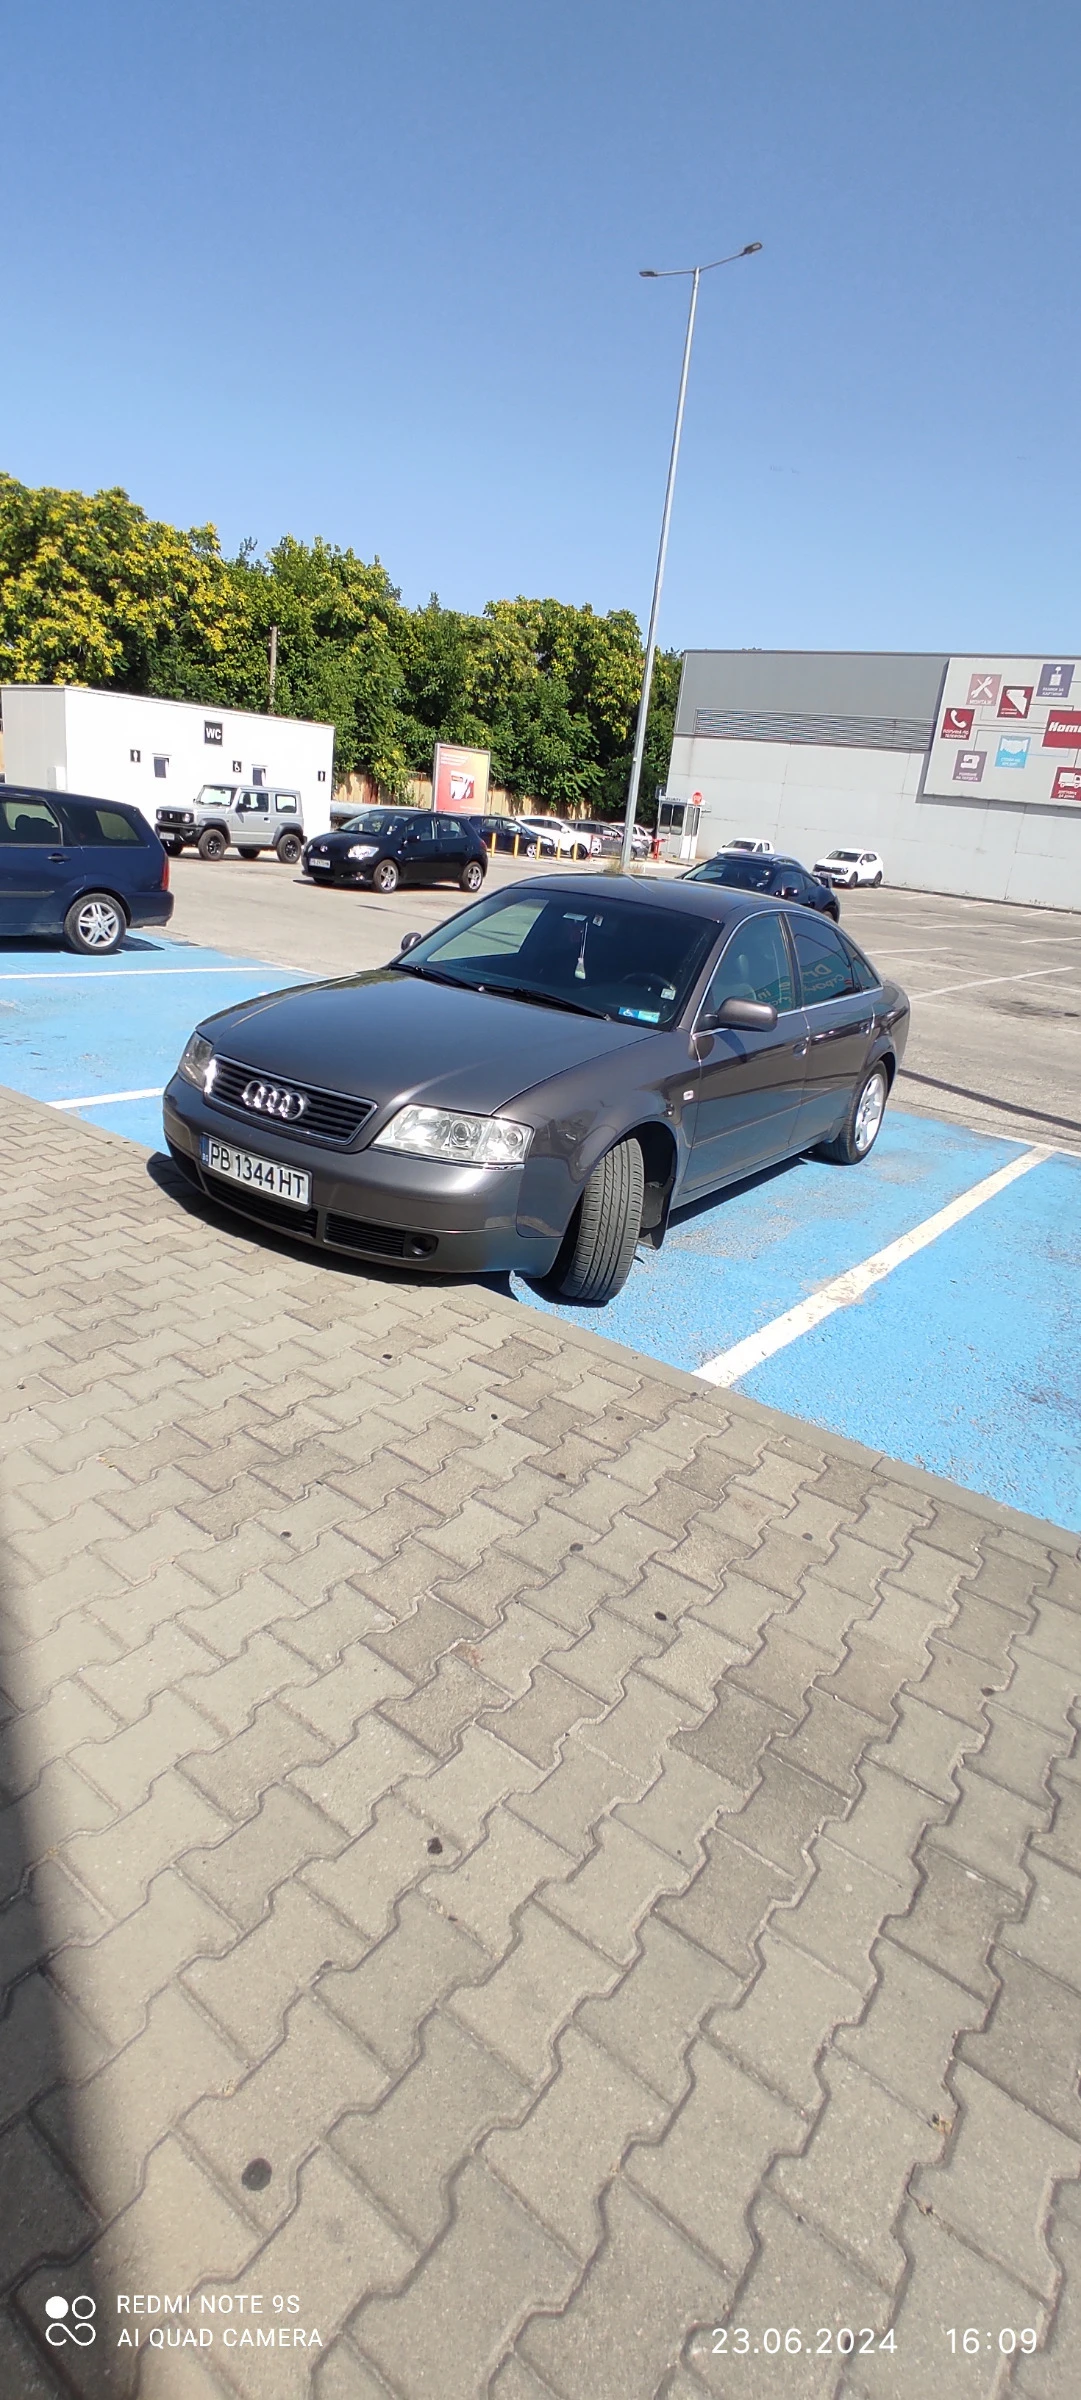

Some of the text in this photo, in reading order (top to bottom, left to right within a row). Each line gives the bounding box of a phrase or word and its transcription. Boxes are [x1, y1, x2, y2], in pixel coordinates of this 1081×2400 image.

[205, 727, 222, 740] WC
[210, 1143, 305, 1199] PB 1344 HT
